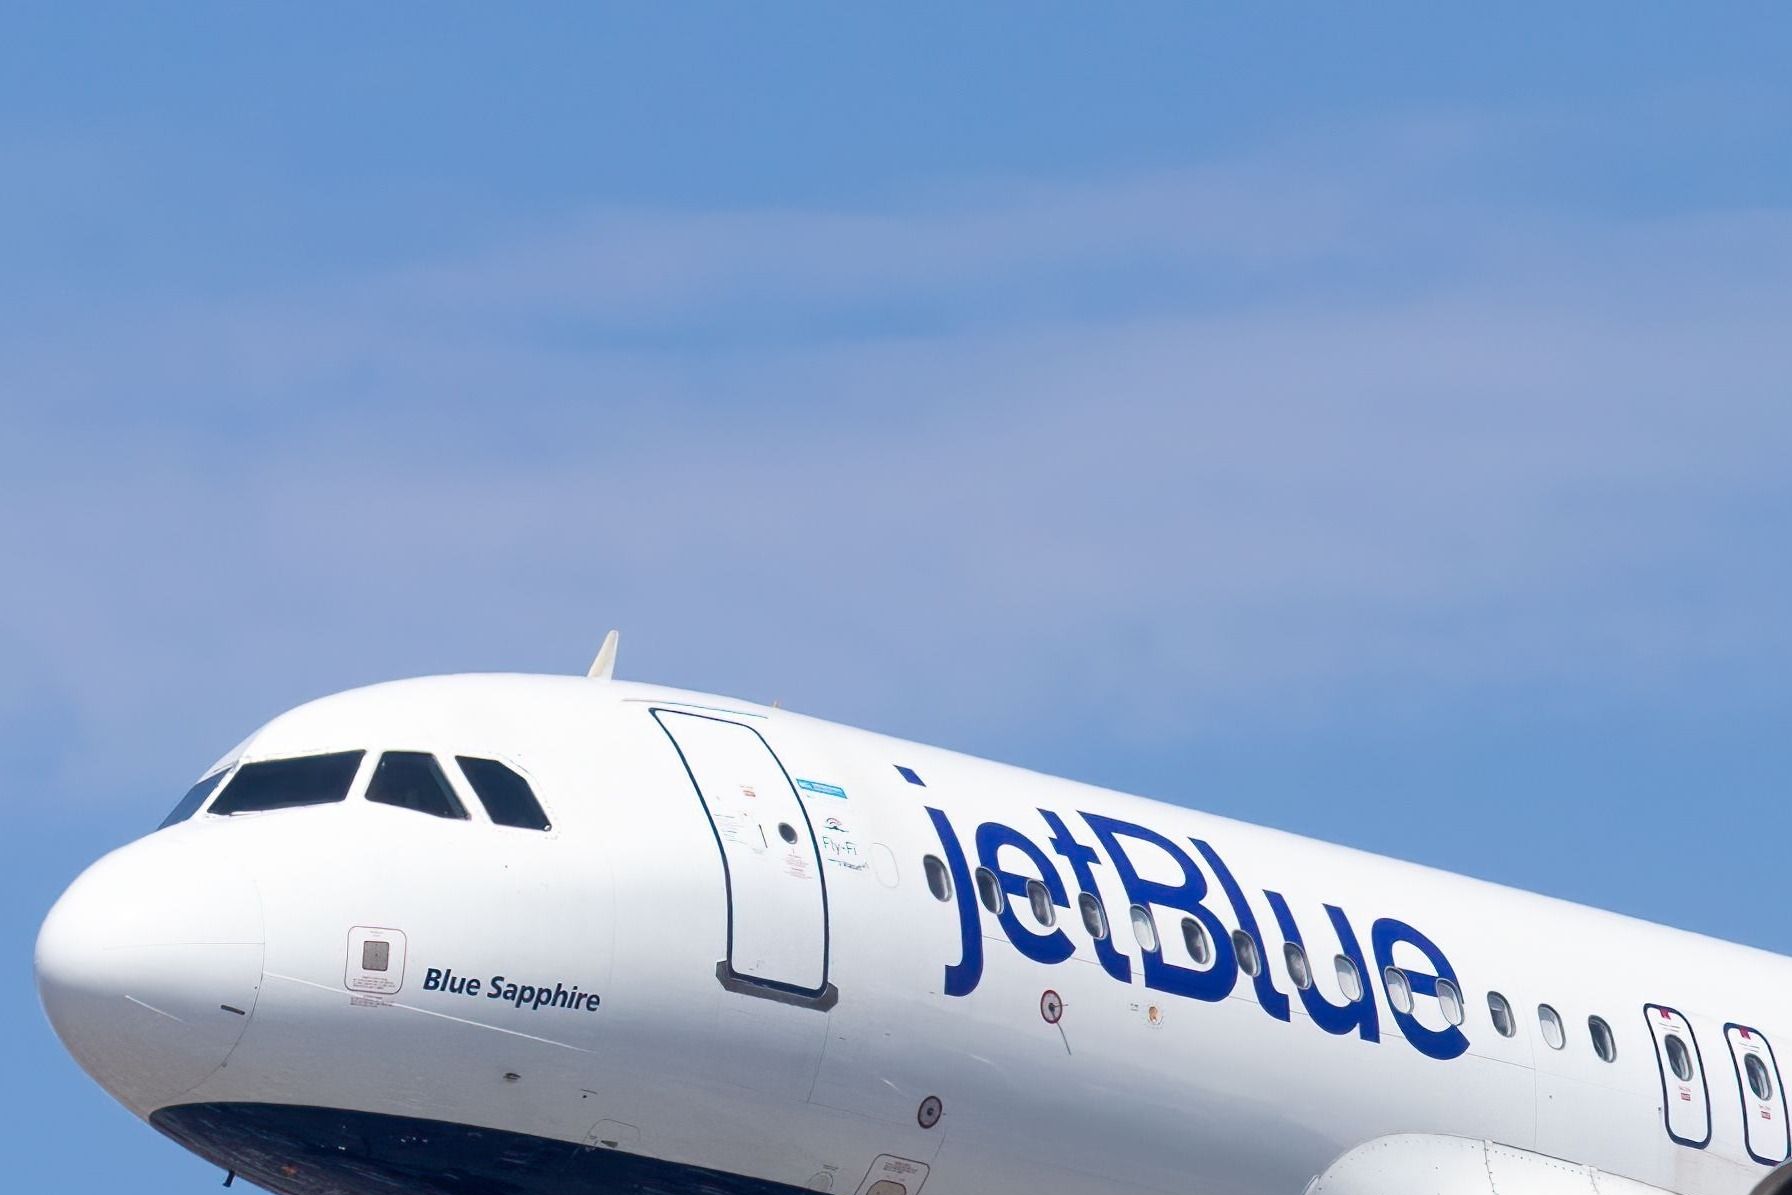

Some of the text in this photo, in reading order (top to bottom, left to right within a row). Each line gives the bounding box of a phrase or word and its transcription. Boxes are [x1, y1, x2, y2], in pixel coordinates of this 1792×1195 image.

[423, 968, 481, 996] Blue
[487, 976, 601, 1012] Sapphire
[893, 764, 1471, 1061] jetBlue
